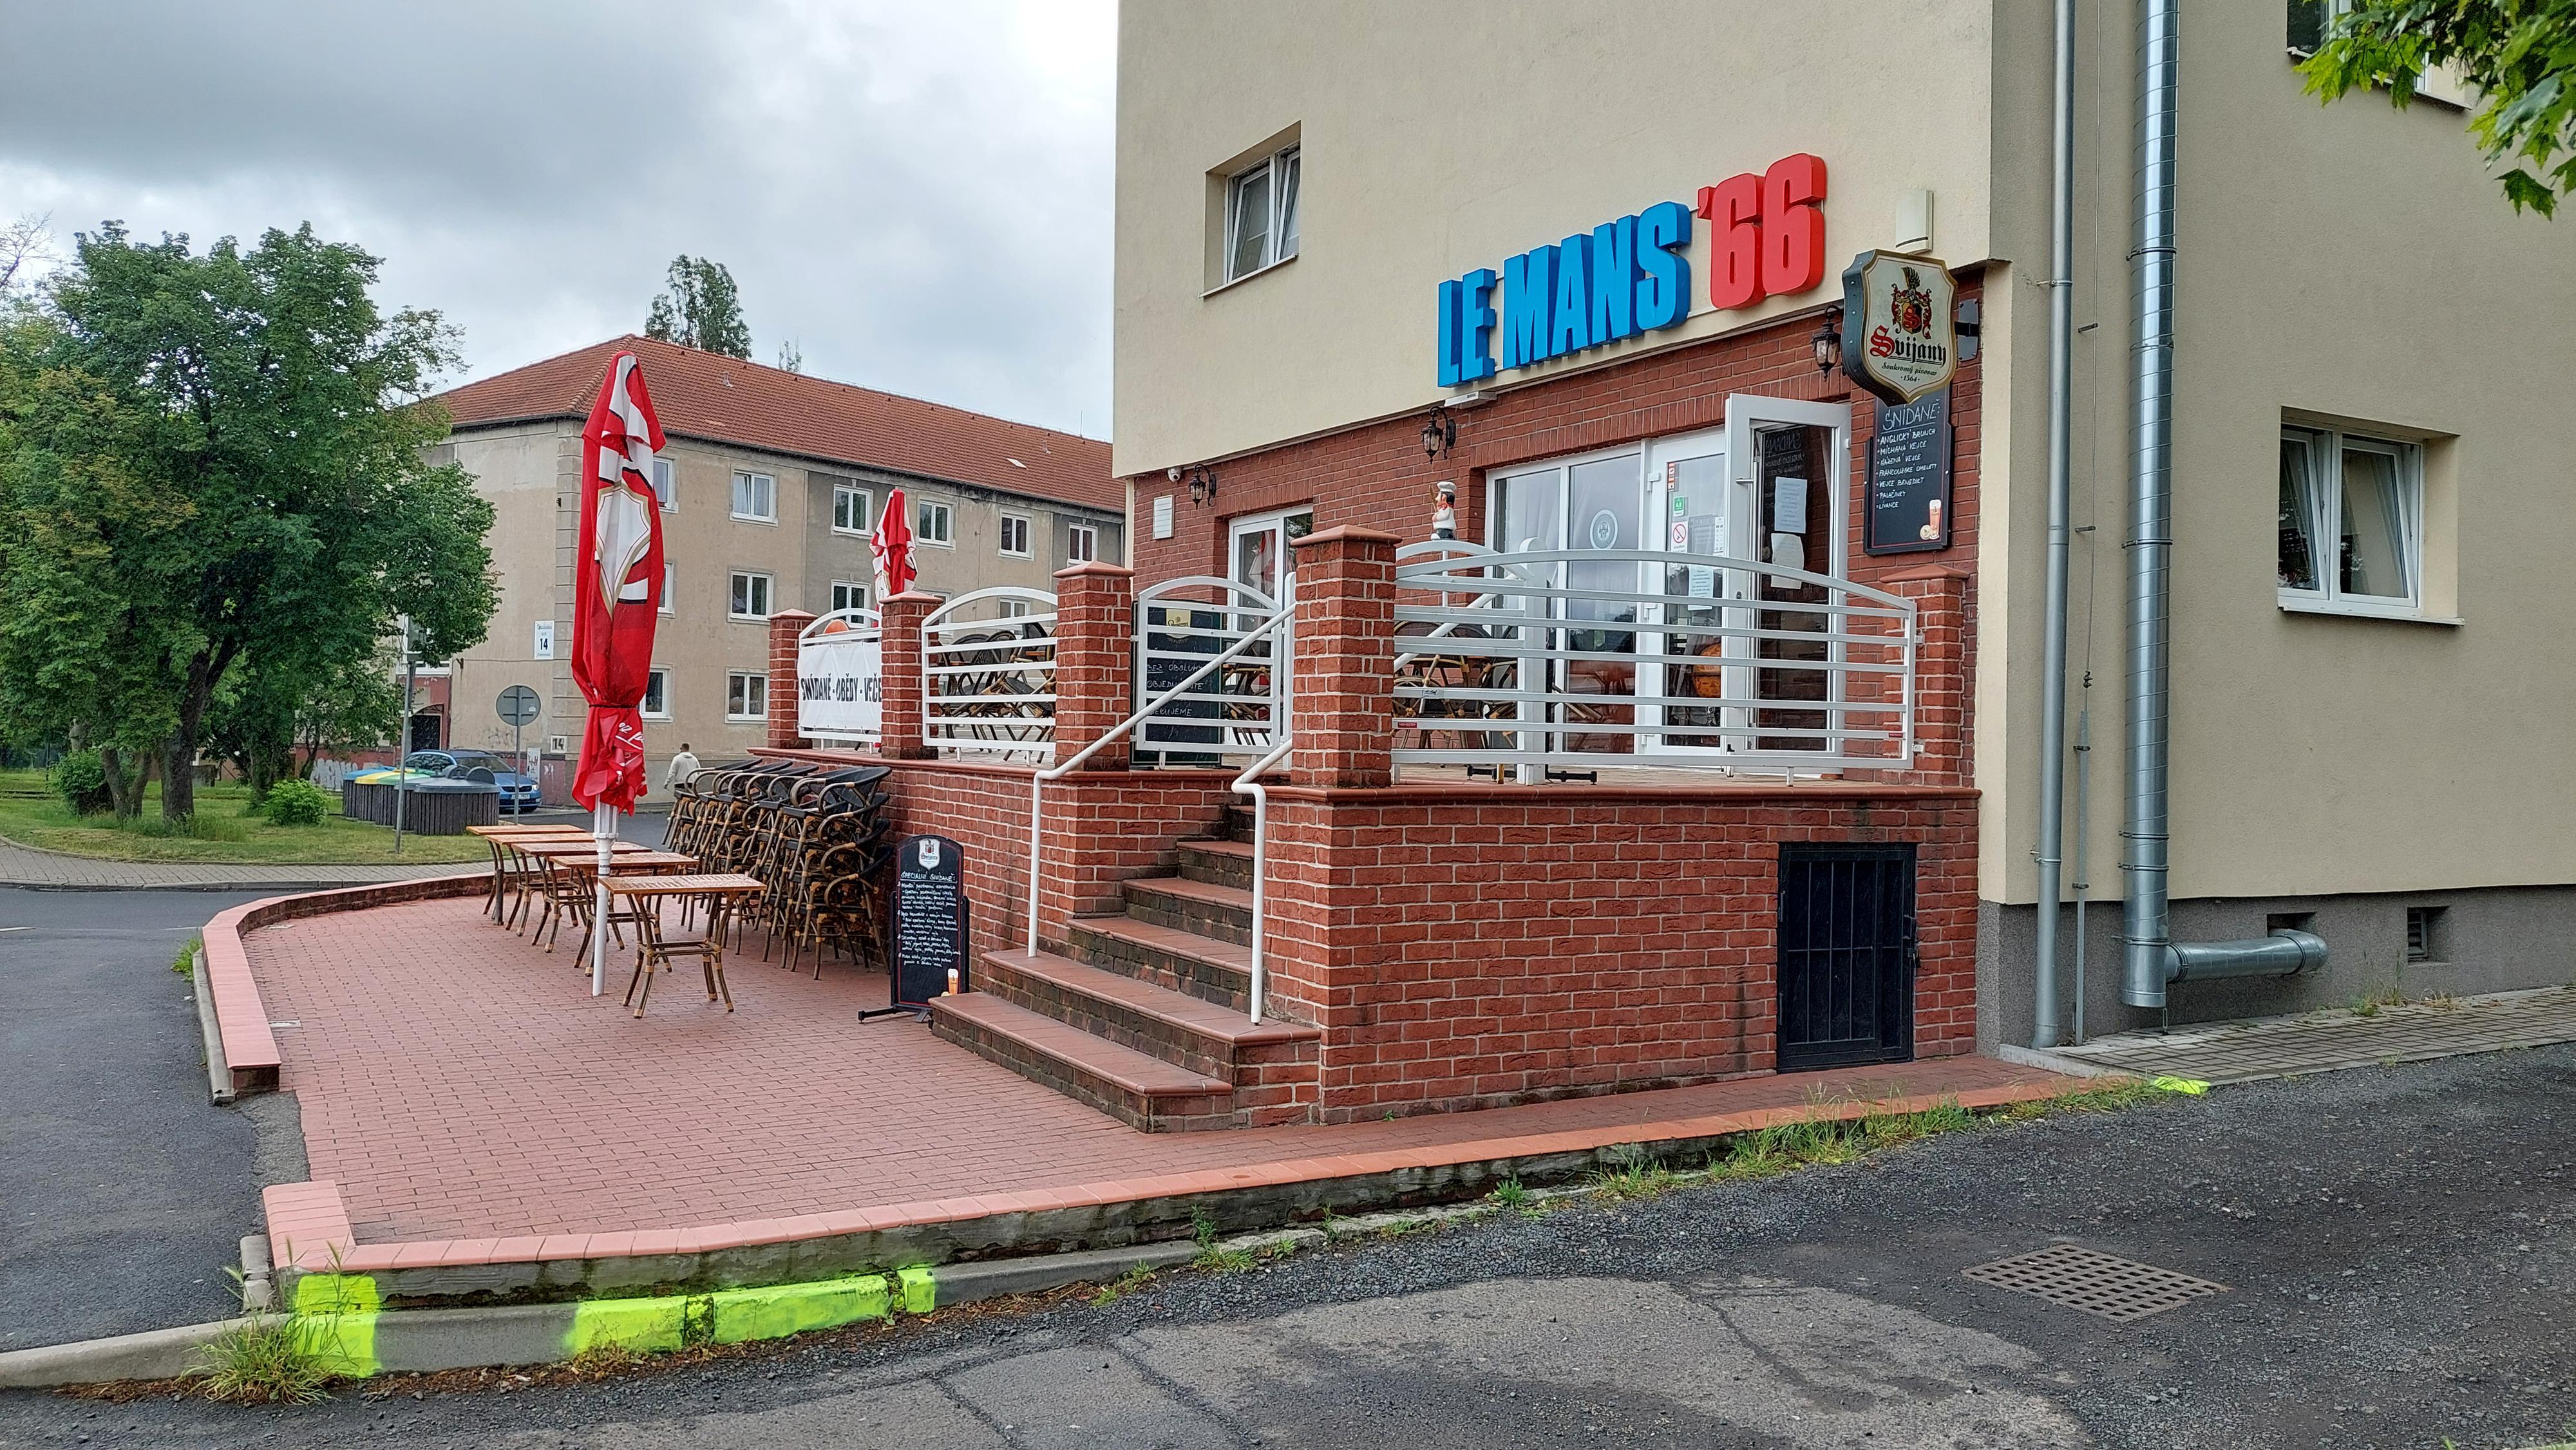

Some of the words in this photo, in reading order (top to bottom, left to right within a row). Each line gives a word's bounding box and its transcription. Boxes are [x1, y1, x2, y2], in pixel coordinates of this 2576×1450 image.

[1438, 268, 1497, 388] LE
[1503, 201, 1691, 370] MANS
[1698, 153, 1826, 310] '66
[1870, 325, 1946, 368] Svijany
[1909, 440, 1927, 449] VEJCE
[1906, 454, 1921, 462] VEJCE
[540, 638, 548, 650] 14
[800, 673, 831, 701] SNÍDANĚ
[836, 673, 858, 702] OBĚDY
[553, 738, 564, 750] 14
